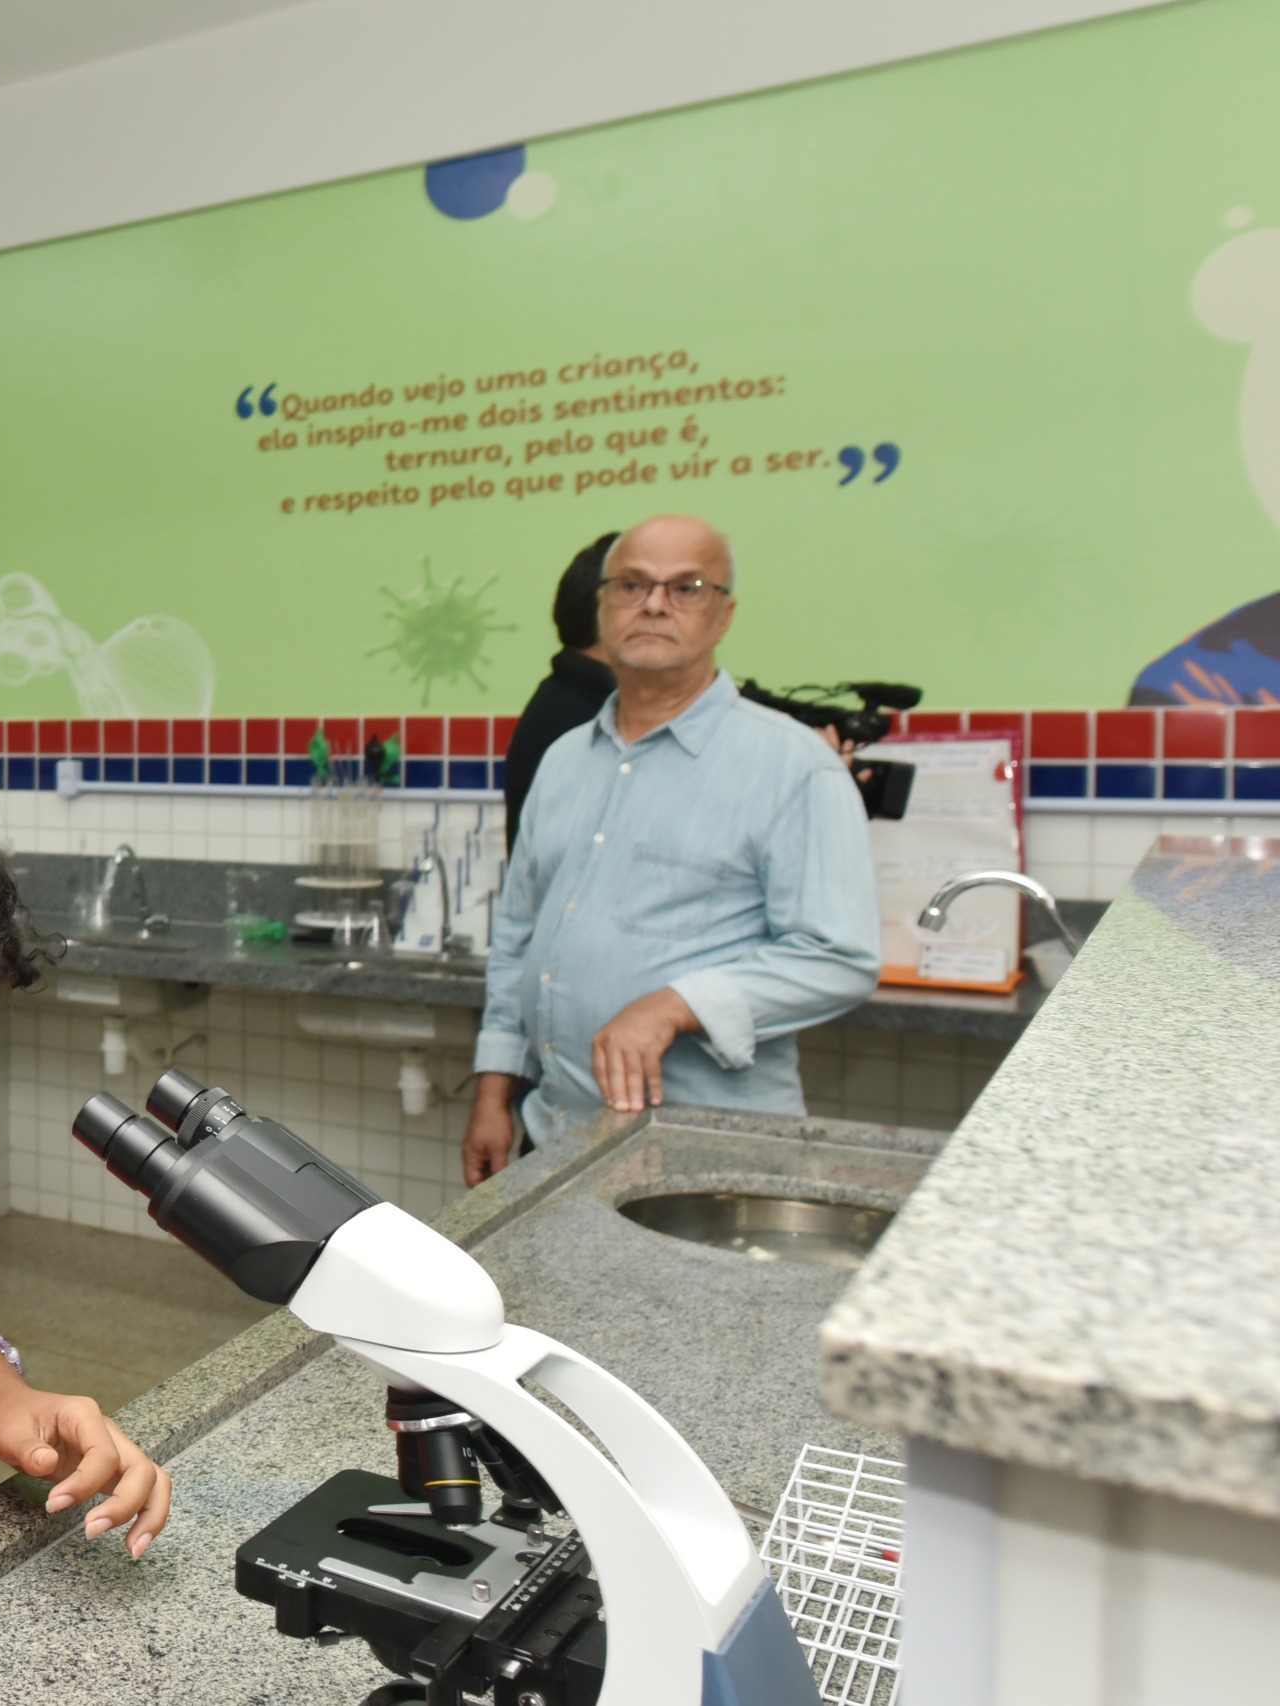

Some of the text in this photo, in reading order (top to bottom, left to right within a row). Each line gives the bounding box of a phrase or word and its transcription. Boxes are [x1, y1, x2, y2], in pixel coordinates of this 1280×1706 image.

[403, 373, 465, 406] vejo
[475, 367, 546, 394] uma
[557, 349, 699, 384] criança,
[257, 375, 786, 453] ela inspira-me dois sentimentos:
[384, 413, 709, 472] ternura, pelo que é,
[280, 496, 295, 515] e
[303, 482, 420, 515] respeito
[428, 475, 494, 508] pelo
[504, 472, 564, 501] que
[574, 459, 658, 496] pode
[669, 452, 719, 481] vir
[730, 455, 751, 476] a
